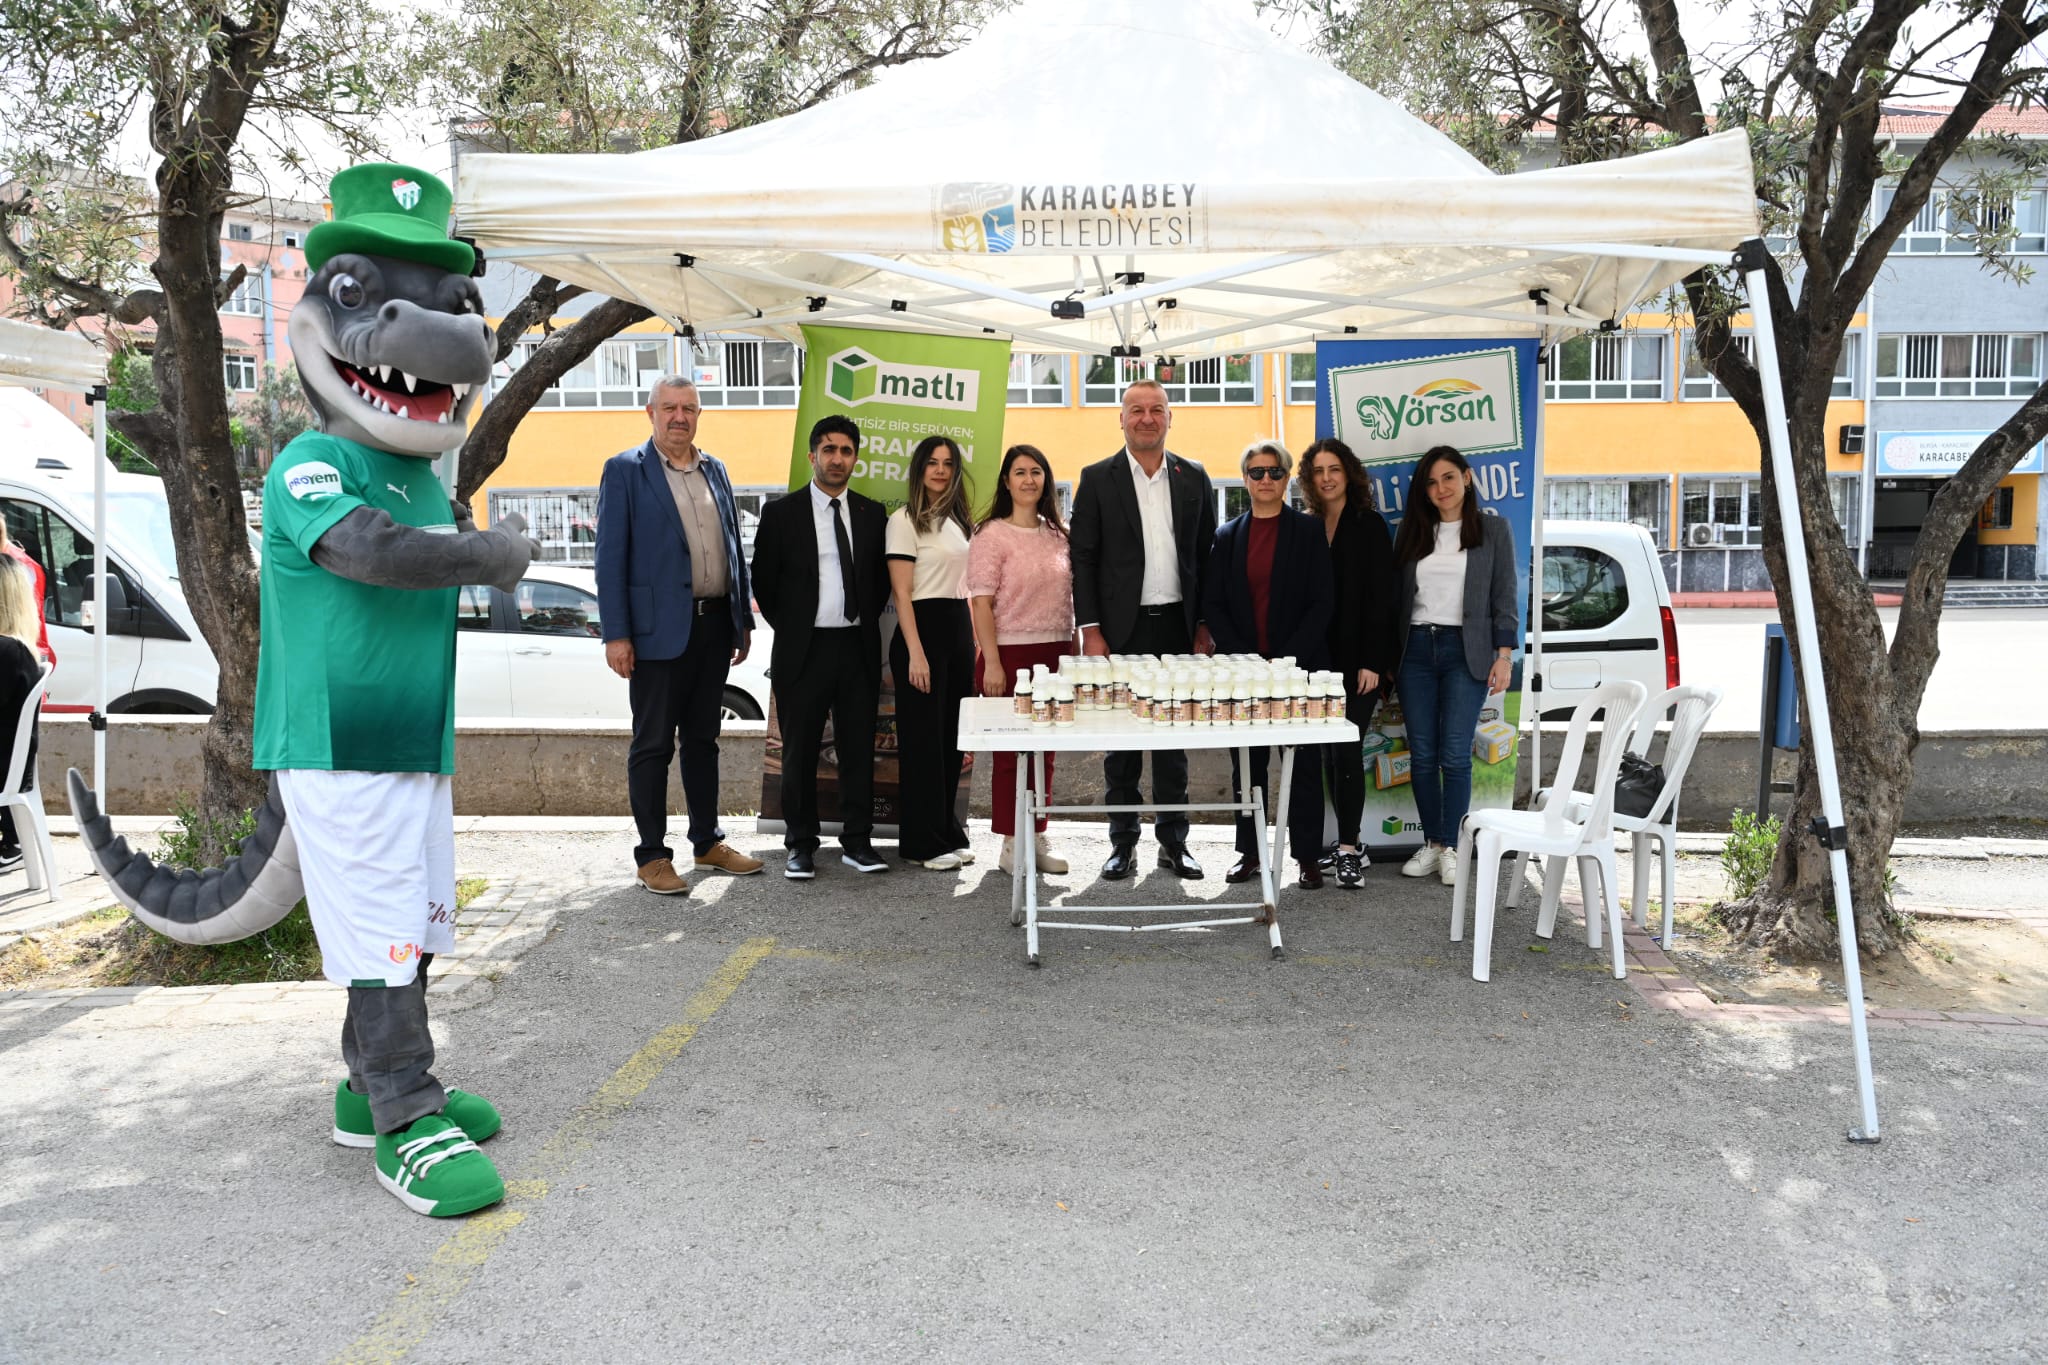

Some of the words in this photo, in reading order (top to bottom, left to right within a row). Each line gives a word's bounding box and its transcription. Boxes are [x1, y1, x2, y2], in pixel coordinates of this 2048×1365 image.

[1020, 183, 1196, 211] KARACABEY
[1022, 211, 1192, 247] BELEDİYESİ
[880, 373, 965, 402] matlı
[888, 418, 910, 432] BİR
[1381, 394, 1496, 440] Yörsan
